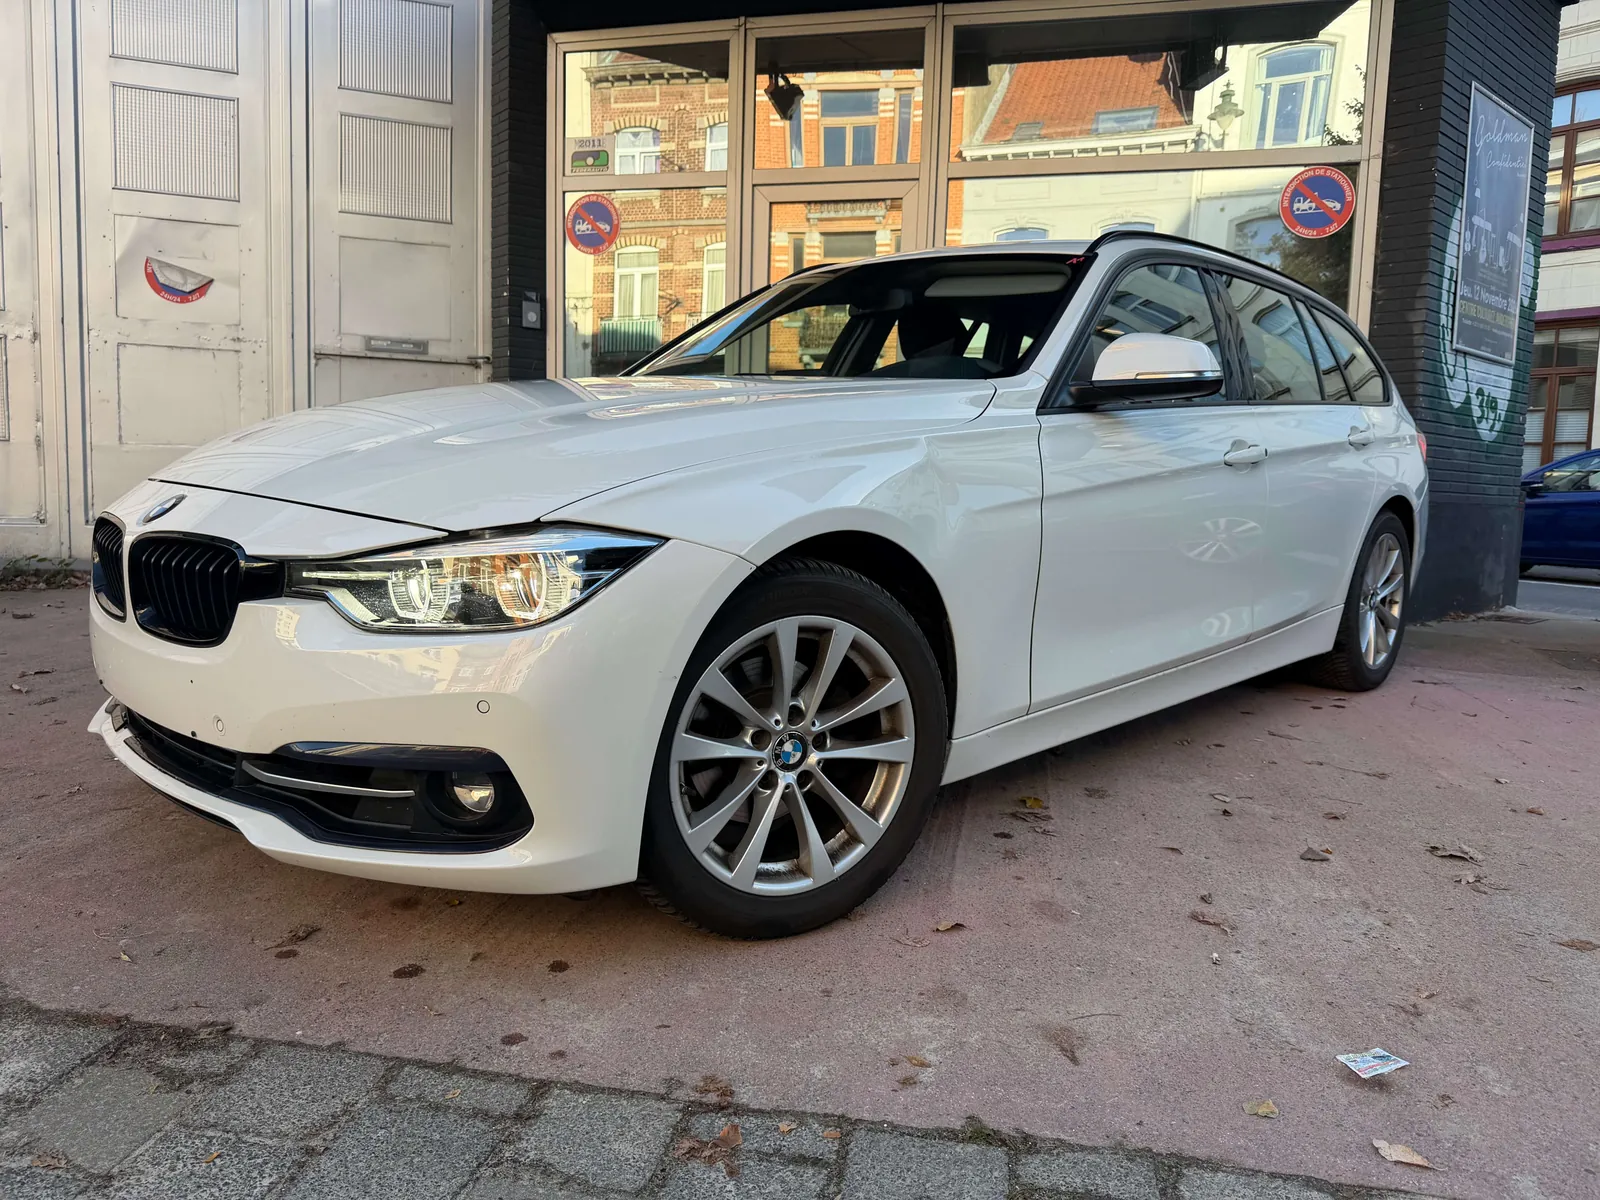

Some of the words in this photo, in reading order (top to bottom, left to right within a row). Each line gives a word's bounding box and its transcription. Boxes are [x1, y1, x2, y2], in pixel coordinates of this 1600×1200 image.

[1475, 115, 1528, 156] Goldman
[1283, 170, 1314, 207] INTERDICTION
[1326, 170, 1352, 202] STATIONNER
[1295, 225, 1317, 236] 24H/24
[1480, 287, 1508, 310] Novembre
